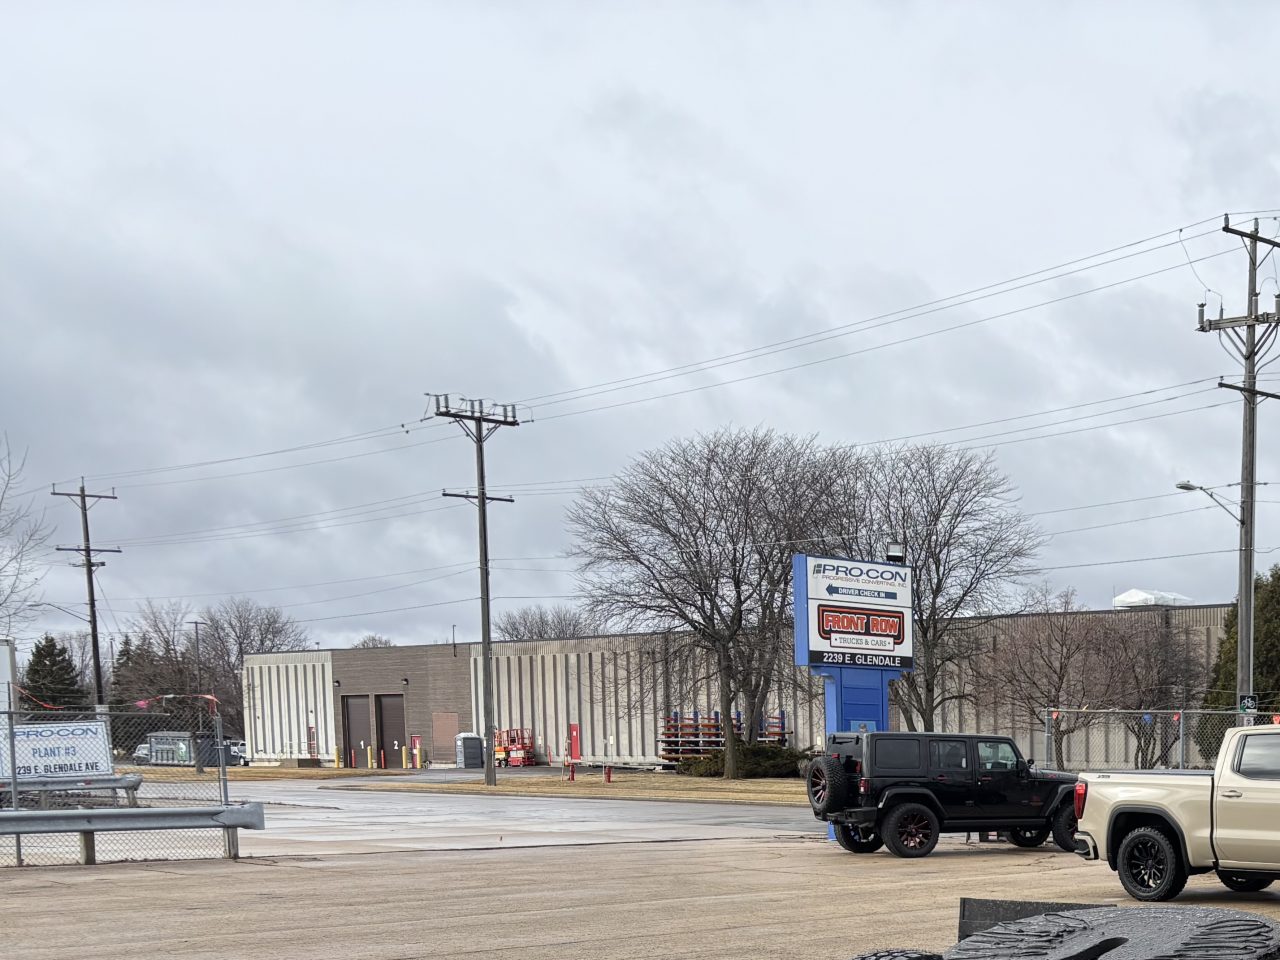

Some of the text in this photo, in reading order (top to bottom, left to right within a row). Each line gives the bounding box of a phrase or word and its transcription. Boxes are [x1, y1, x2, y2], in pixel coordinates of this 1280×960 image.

[860, 589, 878, 597] CHECK
[823, 612, 899, 635] FRONT ROW
[839, 637, 863, 645] TRUCKS
[864, 638, 870, 646] &
[823, 653, 901, 666] 2239 E. GLENDALE
[360, 740, 364, 749] 1
[393, 740, 399, 750] 2
[32, 746, 76, 758] PLANT #3
[44, 763, 83, 773] GLENDALE
[85, 762, 99, 771] AVE
